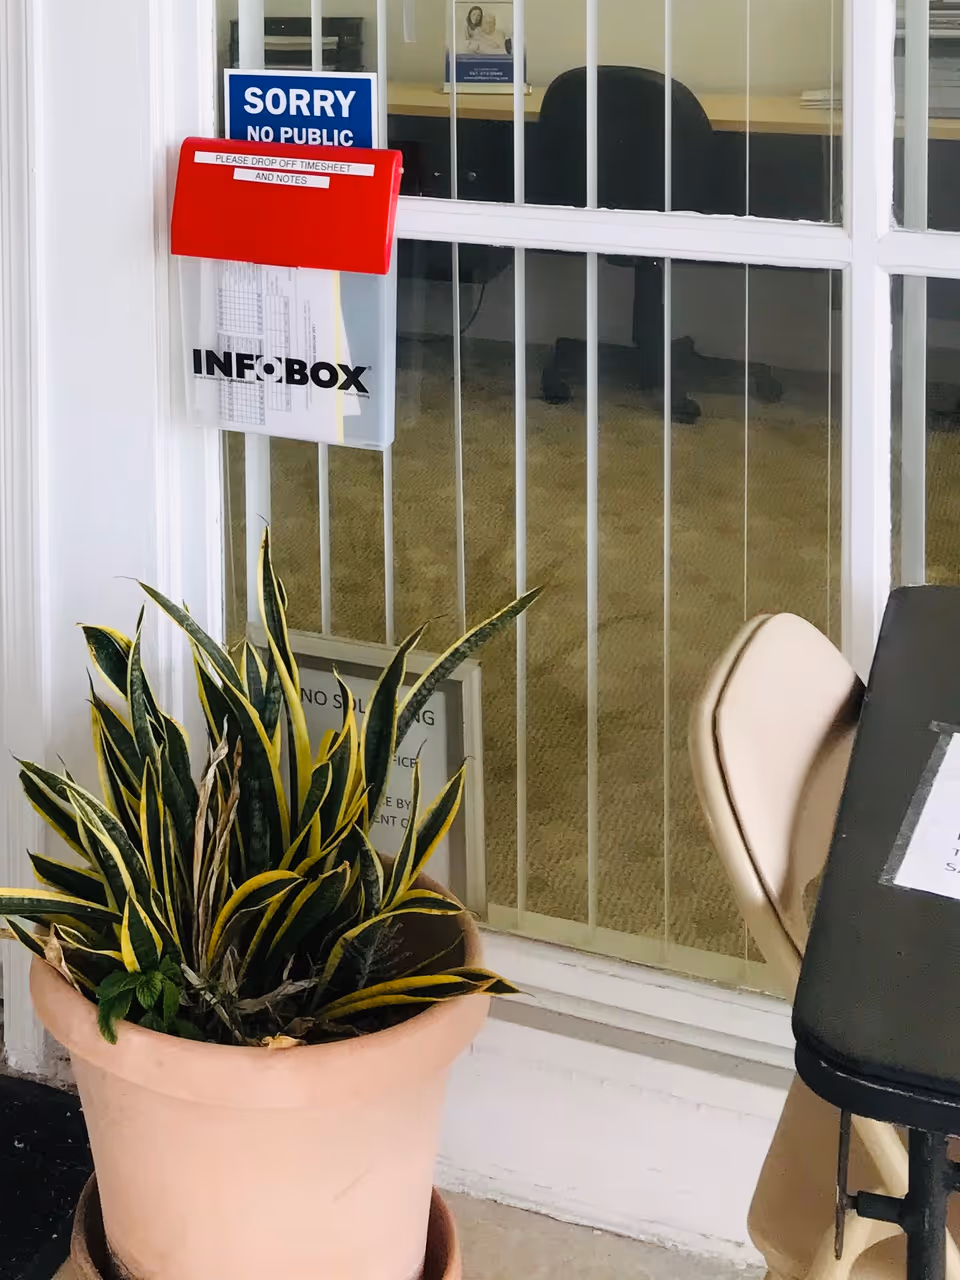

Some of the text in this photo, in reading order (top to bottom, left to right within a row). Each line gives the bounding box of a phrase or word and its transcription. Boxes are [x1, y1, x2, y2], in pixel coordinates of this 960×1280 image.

[243, 86, 357, 118] SORRY
[247, 125, 354, 147] NO PUBLIC
[215, 154, 352, 173] PLEASE DROP OFF TIMESHEET
[255, 172, 308, 185] AND NOTES
[300, 687, 328, 706] NO
